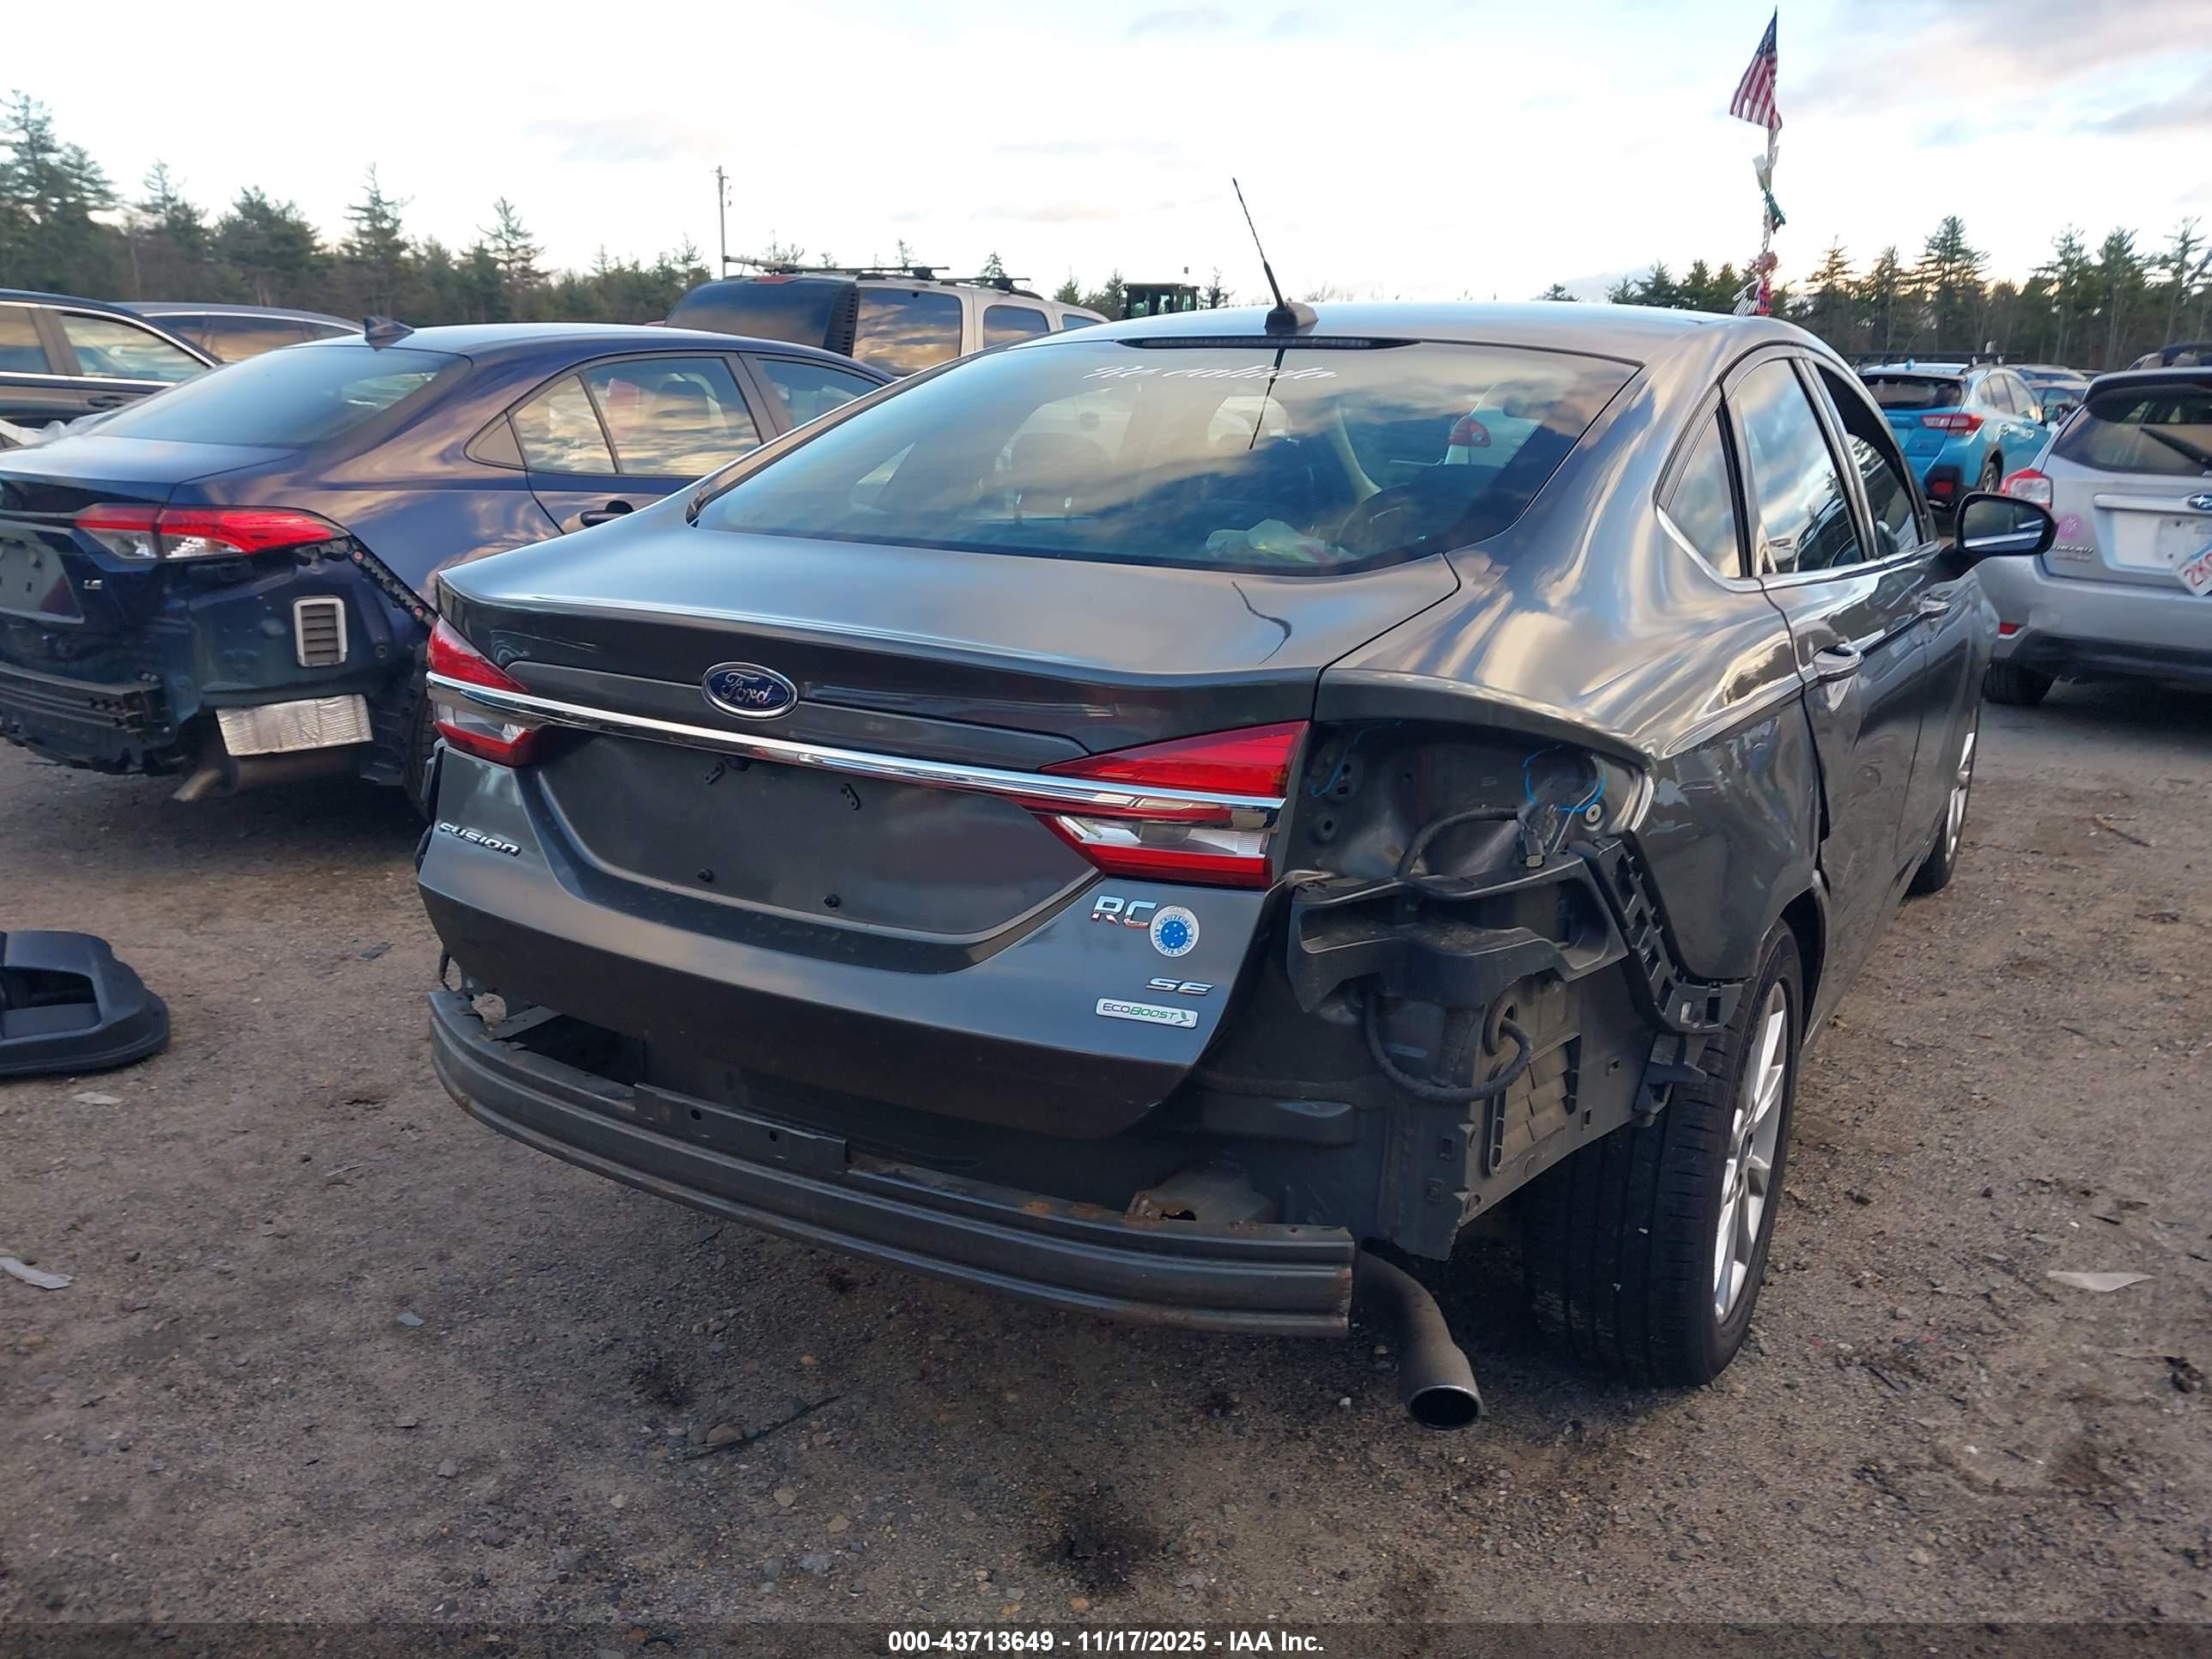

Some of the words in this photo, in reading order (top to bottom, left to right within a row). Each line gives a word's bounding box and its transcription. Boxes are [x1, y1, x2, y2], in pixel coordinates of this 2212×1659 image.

[720, 672, 773, 706] Ford
[1091, 895, 1158, 930] RC
[1145, 976, 1216, 996] SE
[1102, 1001, 1179, 1021] ECOBOOST
